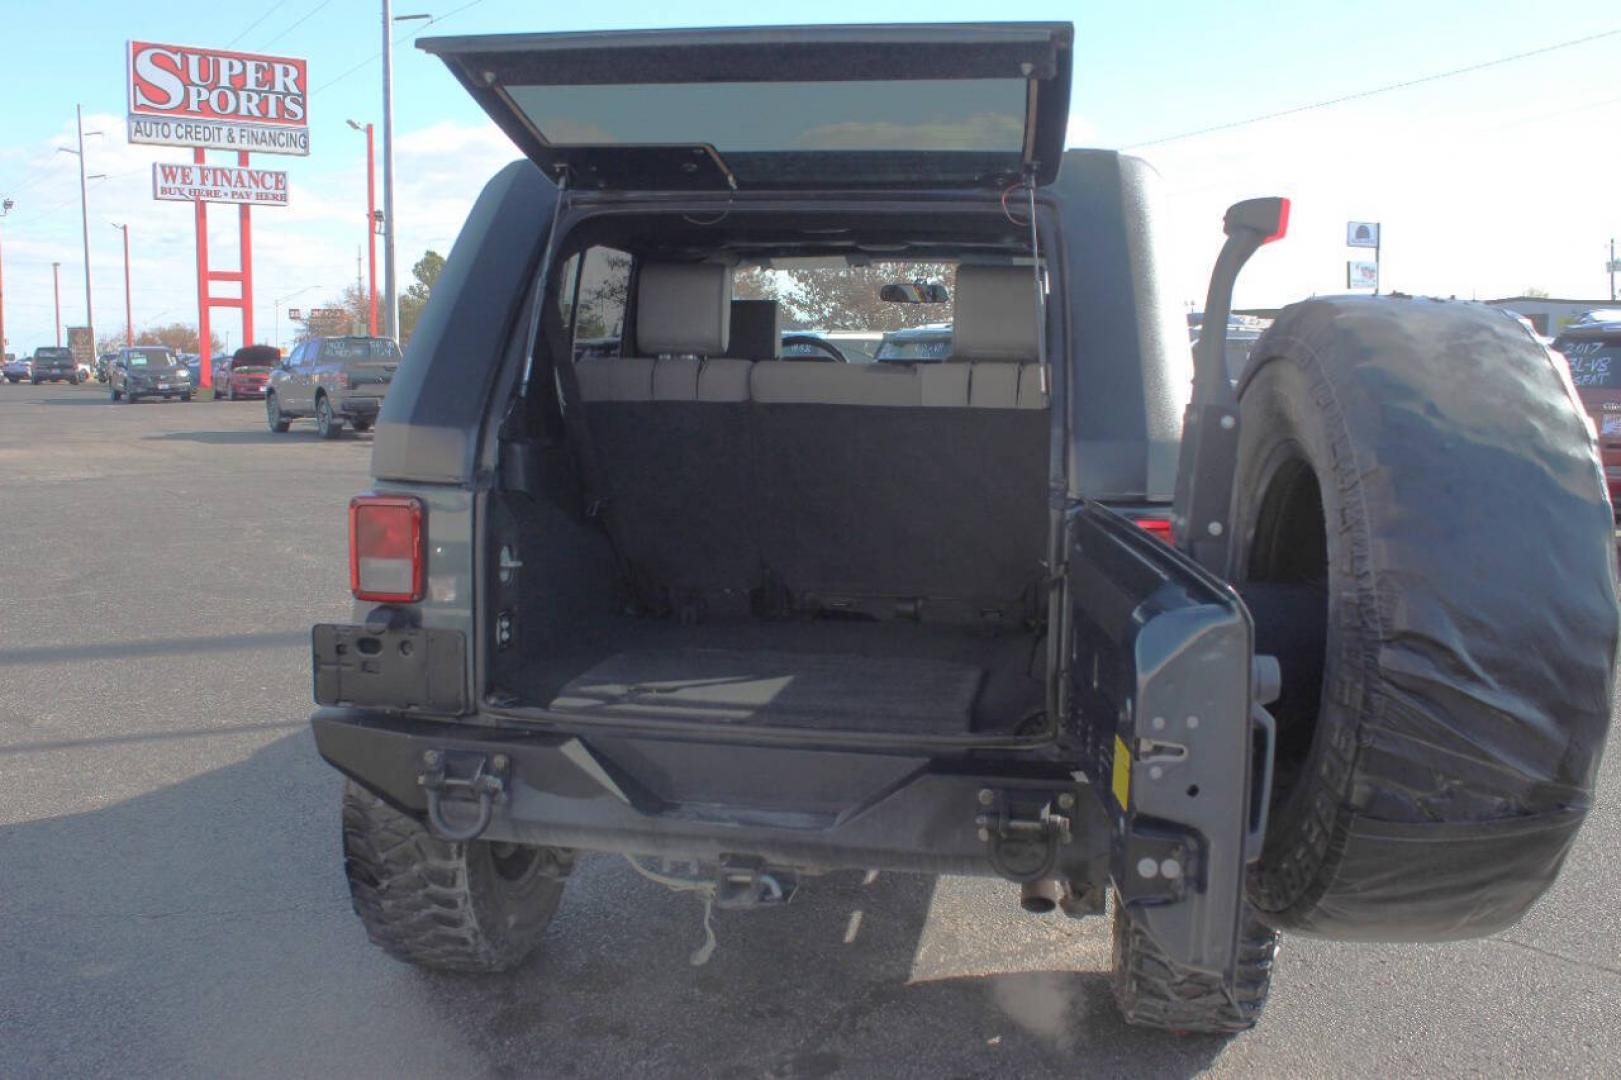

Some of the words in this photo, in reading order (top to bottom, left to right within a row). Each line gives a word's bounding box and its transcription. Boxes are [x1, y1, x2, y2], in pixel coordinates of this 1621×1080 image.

[135, 48, 302, 110] SUPER
[133, 121, 172, 139] AUTO
[175, 123, 223, 143] CREDIT
[227, 129, 236, 144] &
[239, 128, 308, 150] FINANCING
[160, 165, 193, 185] WE
[199, 165, 287, 191] FINANCE
[161, 187, 186, 197] BUY
[188, 188, 222, 199] HERE
[231, 191, 253, 200] PAY
[255, 192, 287, 202] HERE
[1565, 342, 1604, 354] 2017
